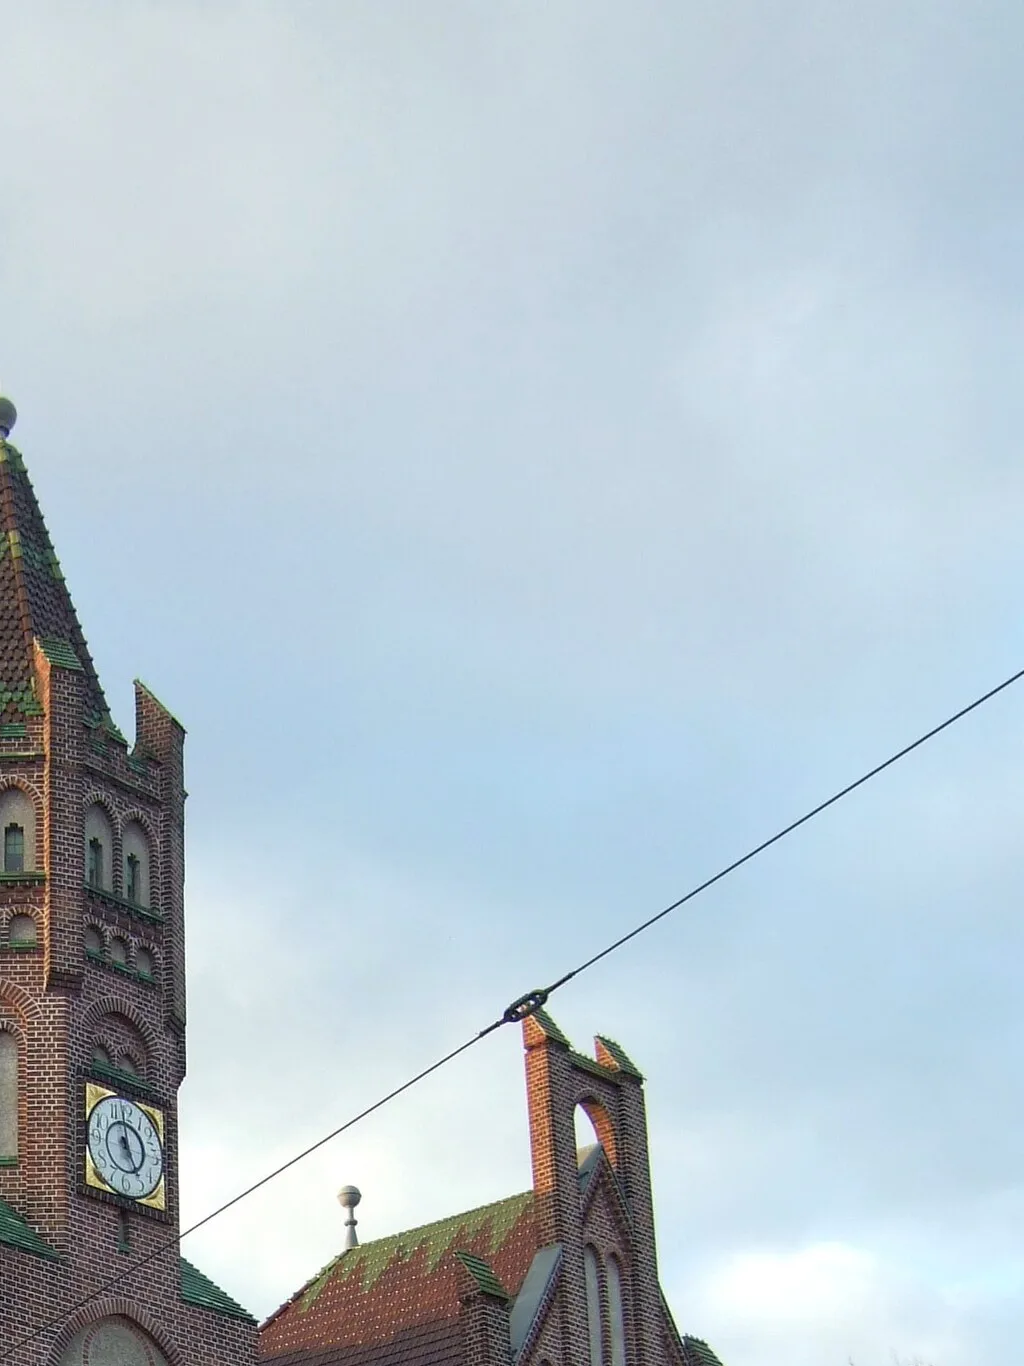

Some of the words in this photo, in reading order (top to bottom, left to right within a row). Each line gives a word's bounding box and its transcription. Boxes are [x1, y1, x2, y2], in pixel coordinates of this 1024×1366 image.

[110, 1103, 118, 1120] 11
[96, 1112, 109, 1131] 10
[121, 1174, 131, 1191] 6
